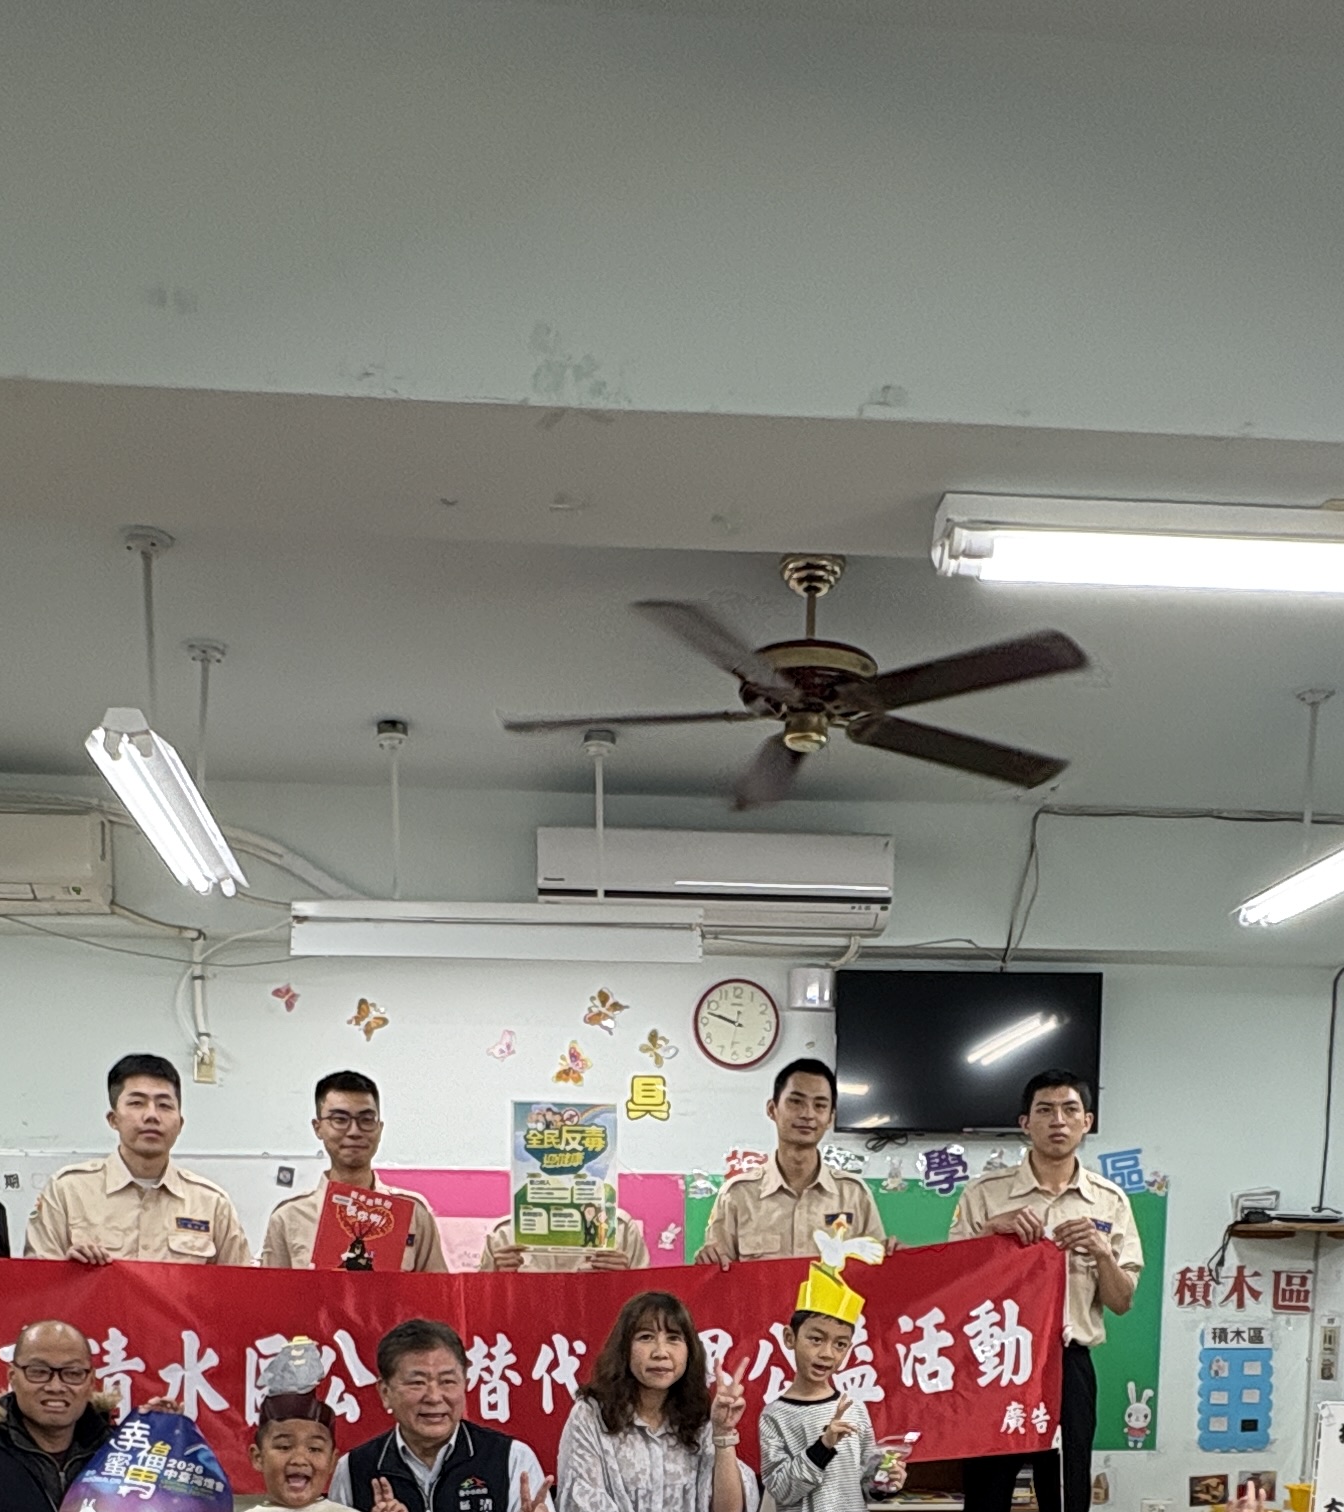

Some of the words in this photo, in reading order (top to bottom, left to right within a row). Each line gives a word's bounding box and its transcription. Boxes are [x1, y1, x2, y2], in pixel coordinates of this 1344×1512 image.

[719, 988, 728, 1001] 11
[733, 986, 744, 999] 12
[707, 999, 720, 1012] 10
[759, 1003, 768, 1015] 2
[700, 1016, 709, 1027] 9
[763, 1020, 772, 1032] 3
[704, 1032, 713, 1044] 8
[757, 1036, 766, 1046] 4
[717, 1044, 725, 1056] 7
[730, 1050, 739, 1061] 6
[745, 1046, 754, 1058] 5
[526, 1125, 606, 1151] 全民反毒
[923, 1146, 969, 1195] 學
[1097, 1148, 1146, 1194] 區
[1174, 1265, 1313, 1312] 積木區
[1211, 1327, 1265, 1345] 積木區
[1000, 1400, 1052, 1435] 廣告
[166, 1459, 203, 1475] 2026
